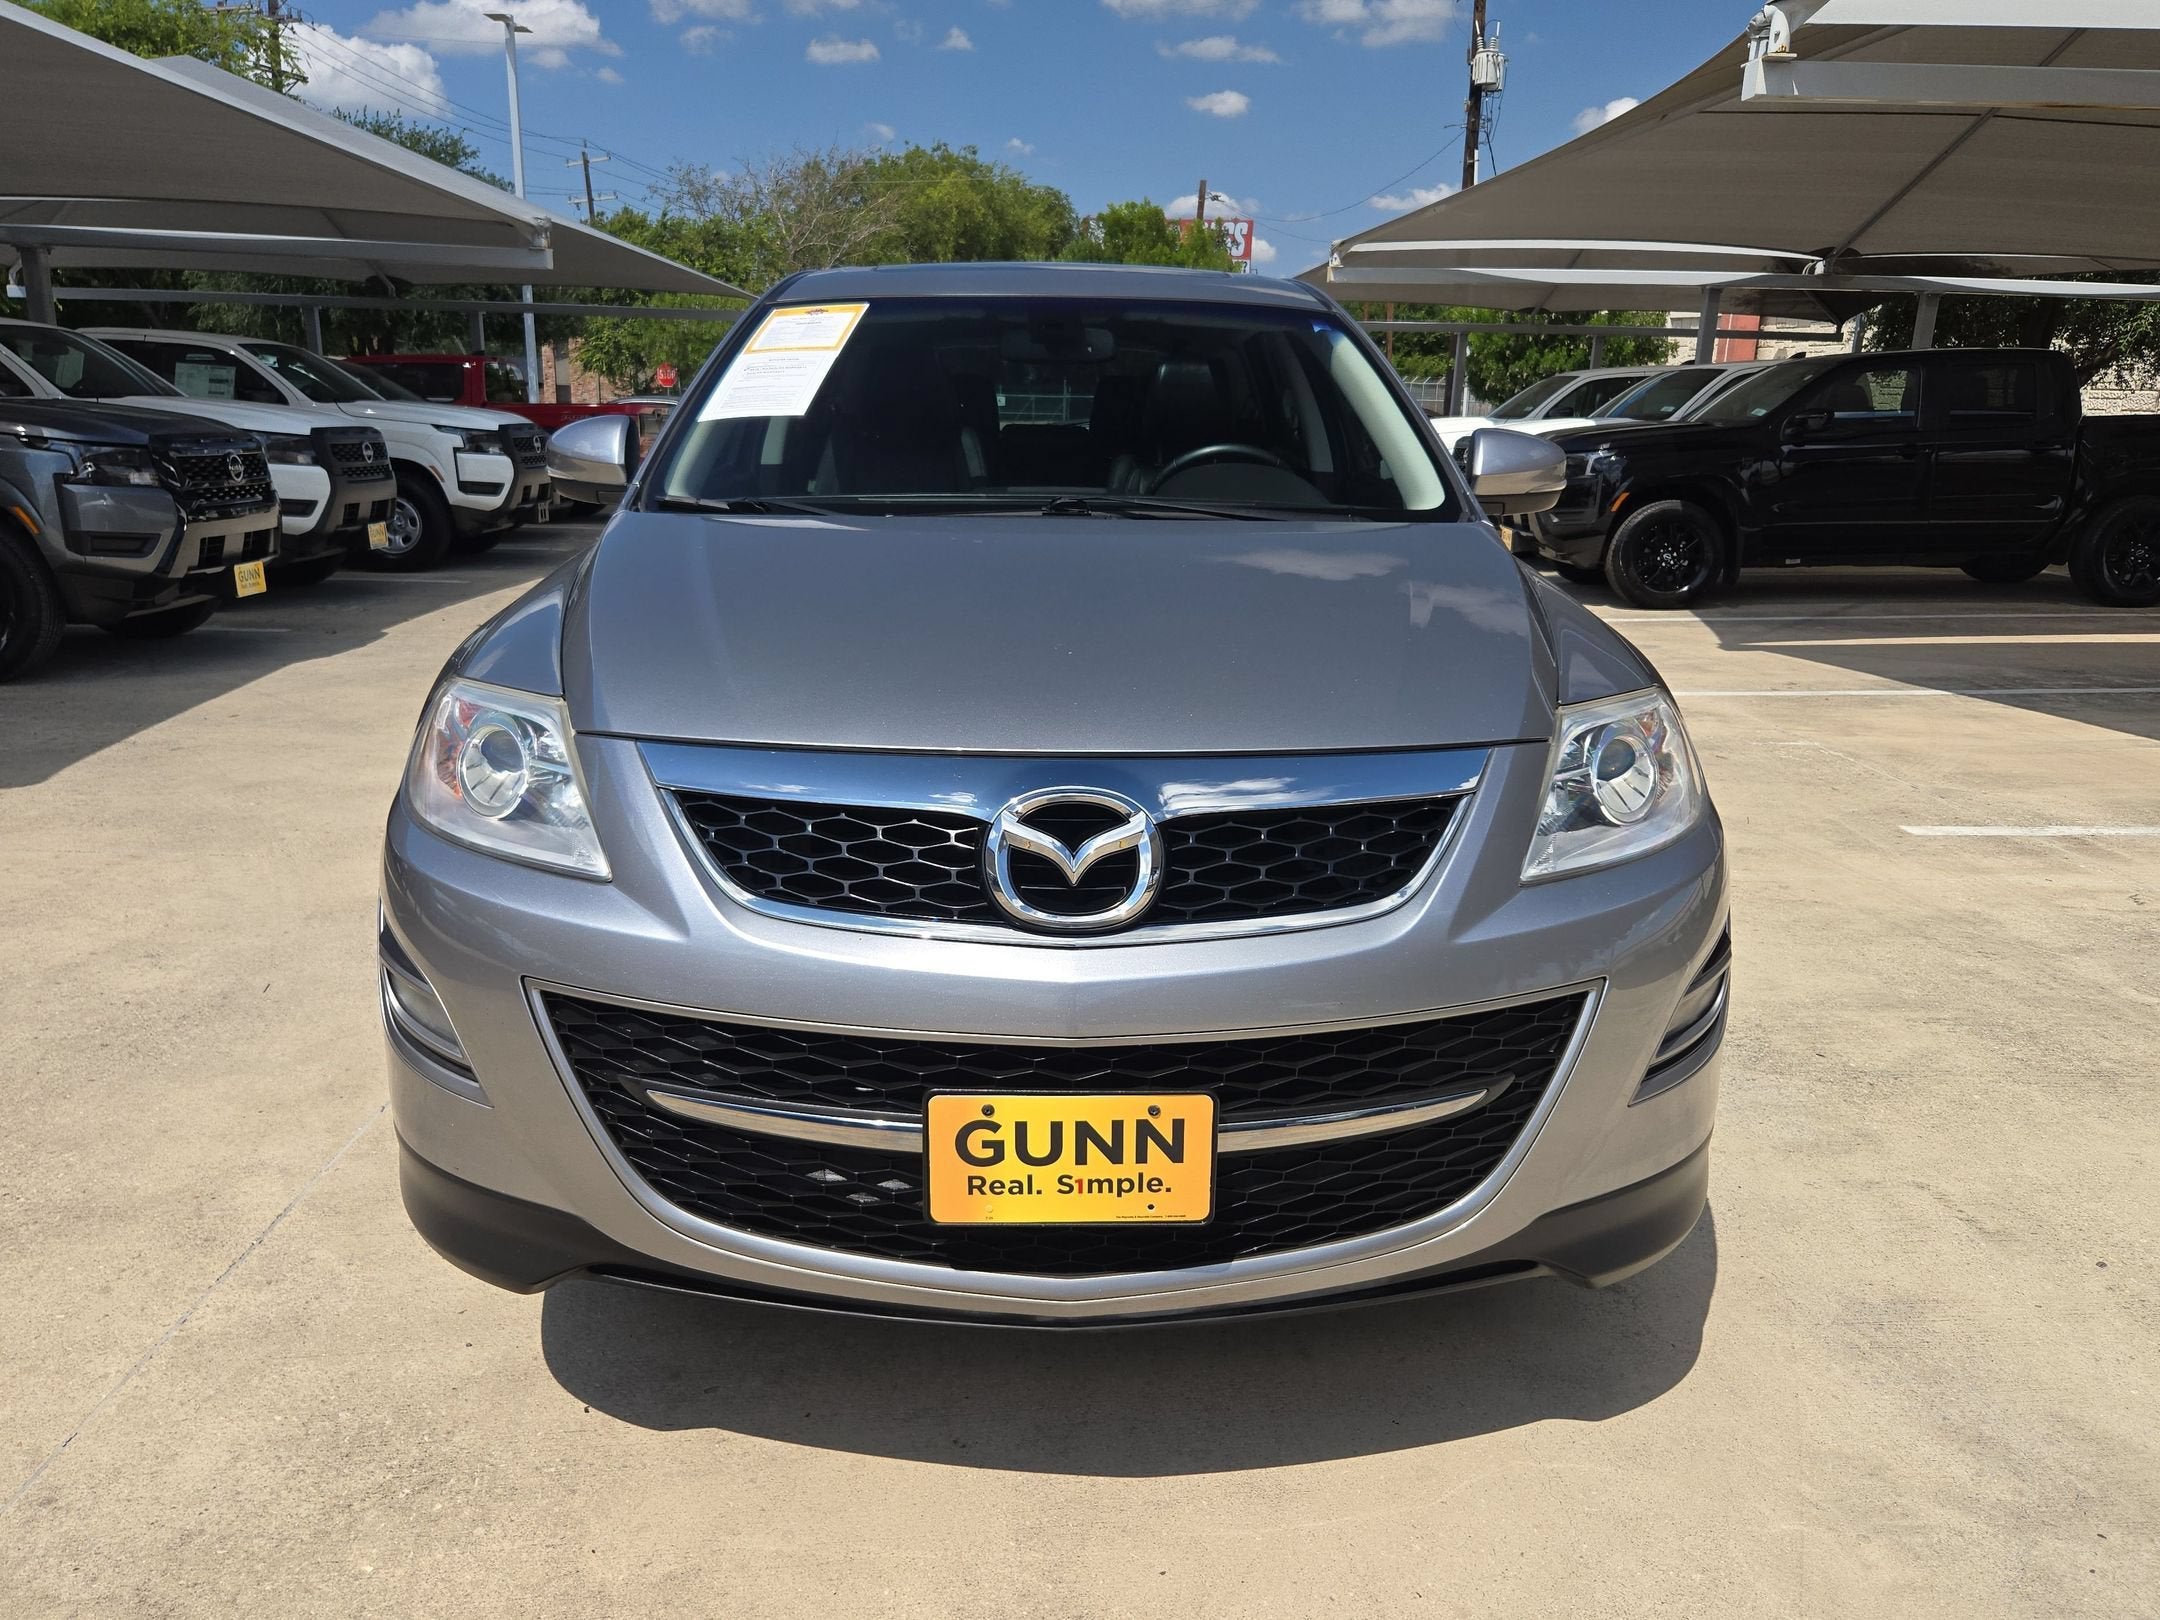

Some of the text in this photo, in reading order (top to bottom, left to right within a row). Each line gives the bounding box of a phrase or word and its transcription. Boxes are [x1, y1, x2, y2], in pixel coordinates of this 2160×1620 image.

[238, 567, 261, 583] GUNN
[955, 1118, 1185, 1167] GUNN
[968, 1172, 1172, 1198] Real. S1mple.
